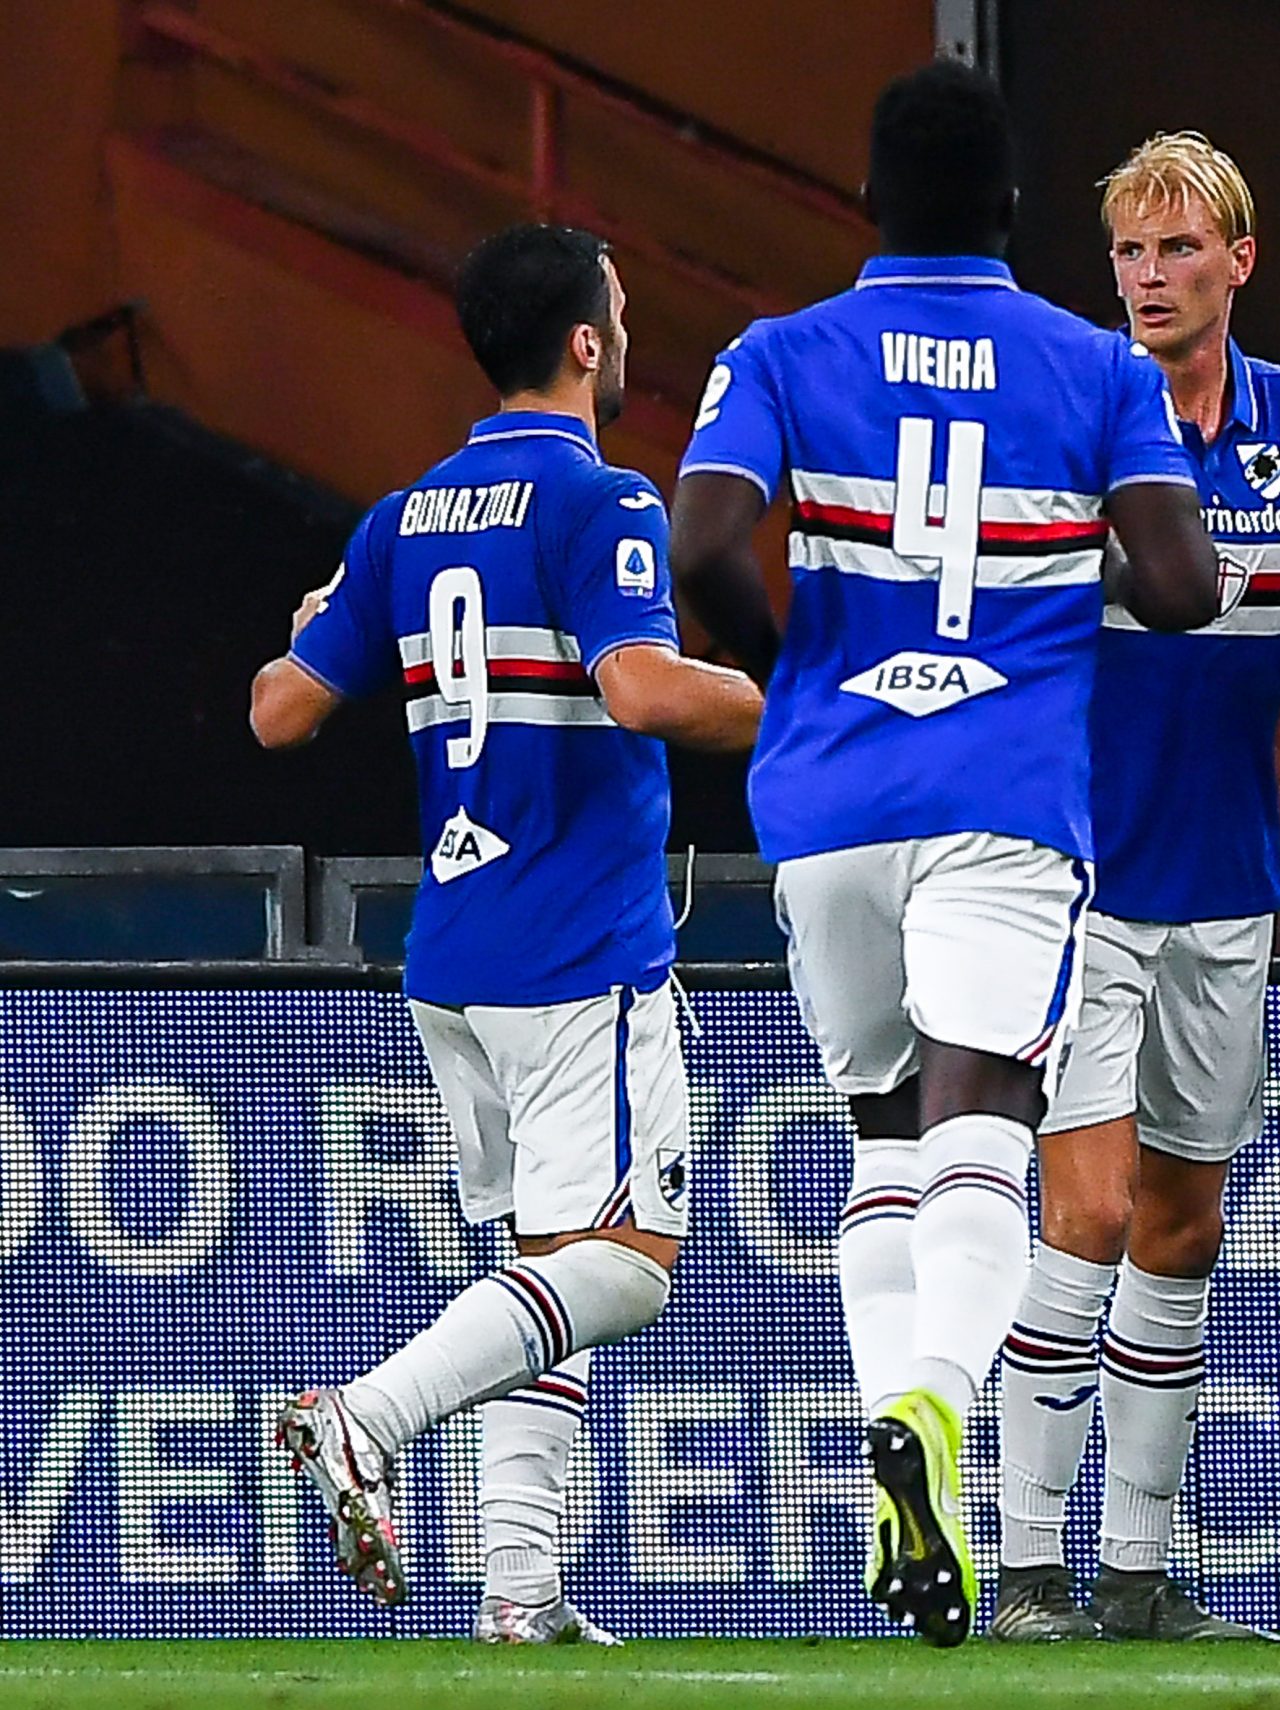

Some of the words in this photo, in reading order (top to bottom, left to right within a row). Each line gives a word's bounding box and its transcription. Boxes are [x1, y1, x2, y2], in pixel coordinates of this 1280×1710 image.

[880, 330, 998, 391] VIEIRA
[893, 416, 986, 641] 4
[429, 566, 488, 770] 9
[874, 662, 970, 695] IBSA
